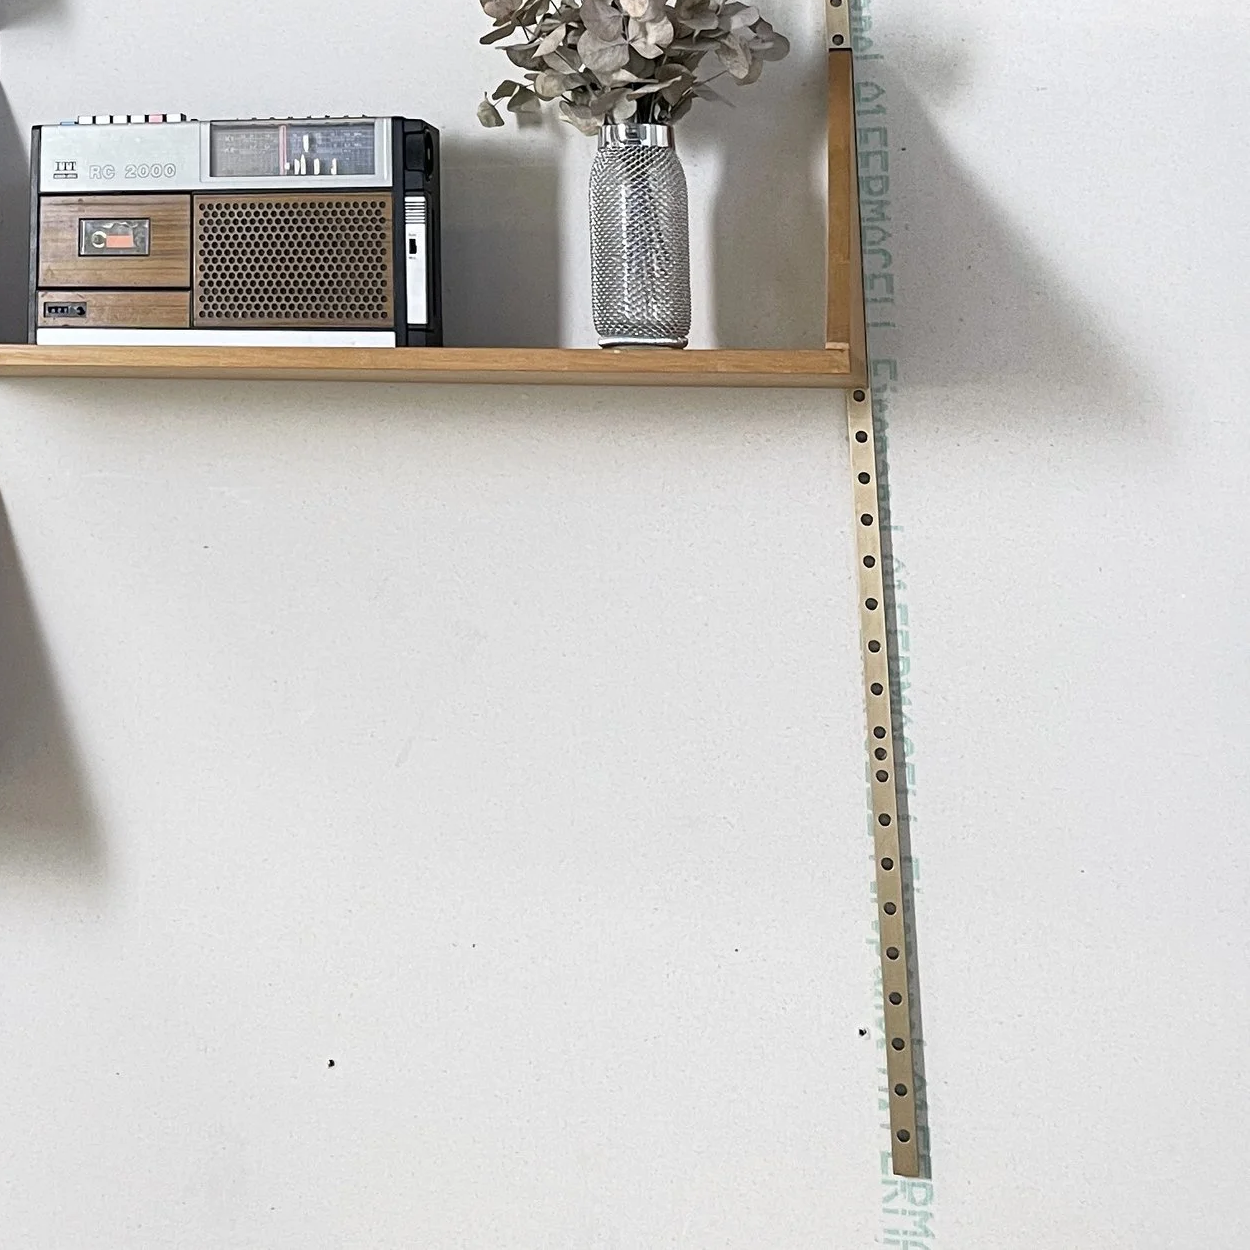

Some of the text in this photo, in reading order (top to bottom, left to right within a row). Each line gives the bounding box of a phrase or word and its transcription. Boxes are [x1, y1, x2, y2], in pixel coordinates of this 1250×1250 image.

[55, 161, 77, 172] ITT
[89, 164, 116, 180] RC
[124, 162, 177, 179] 2000
